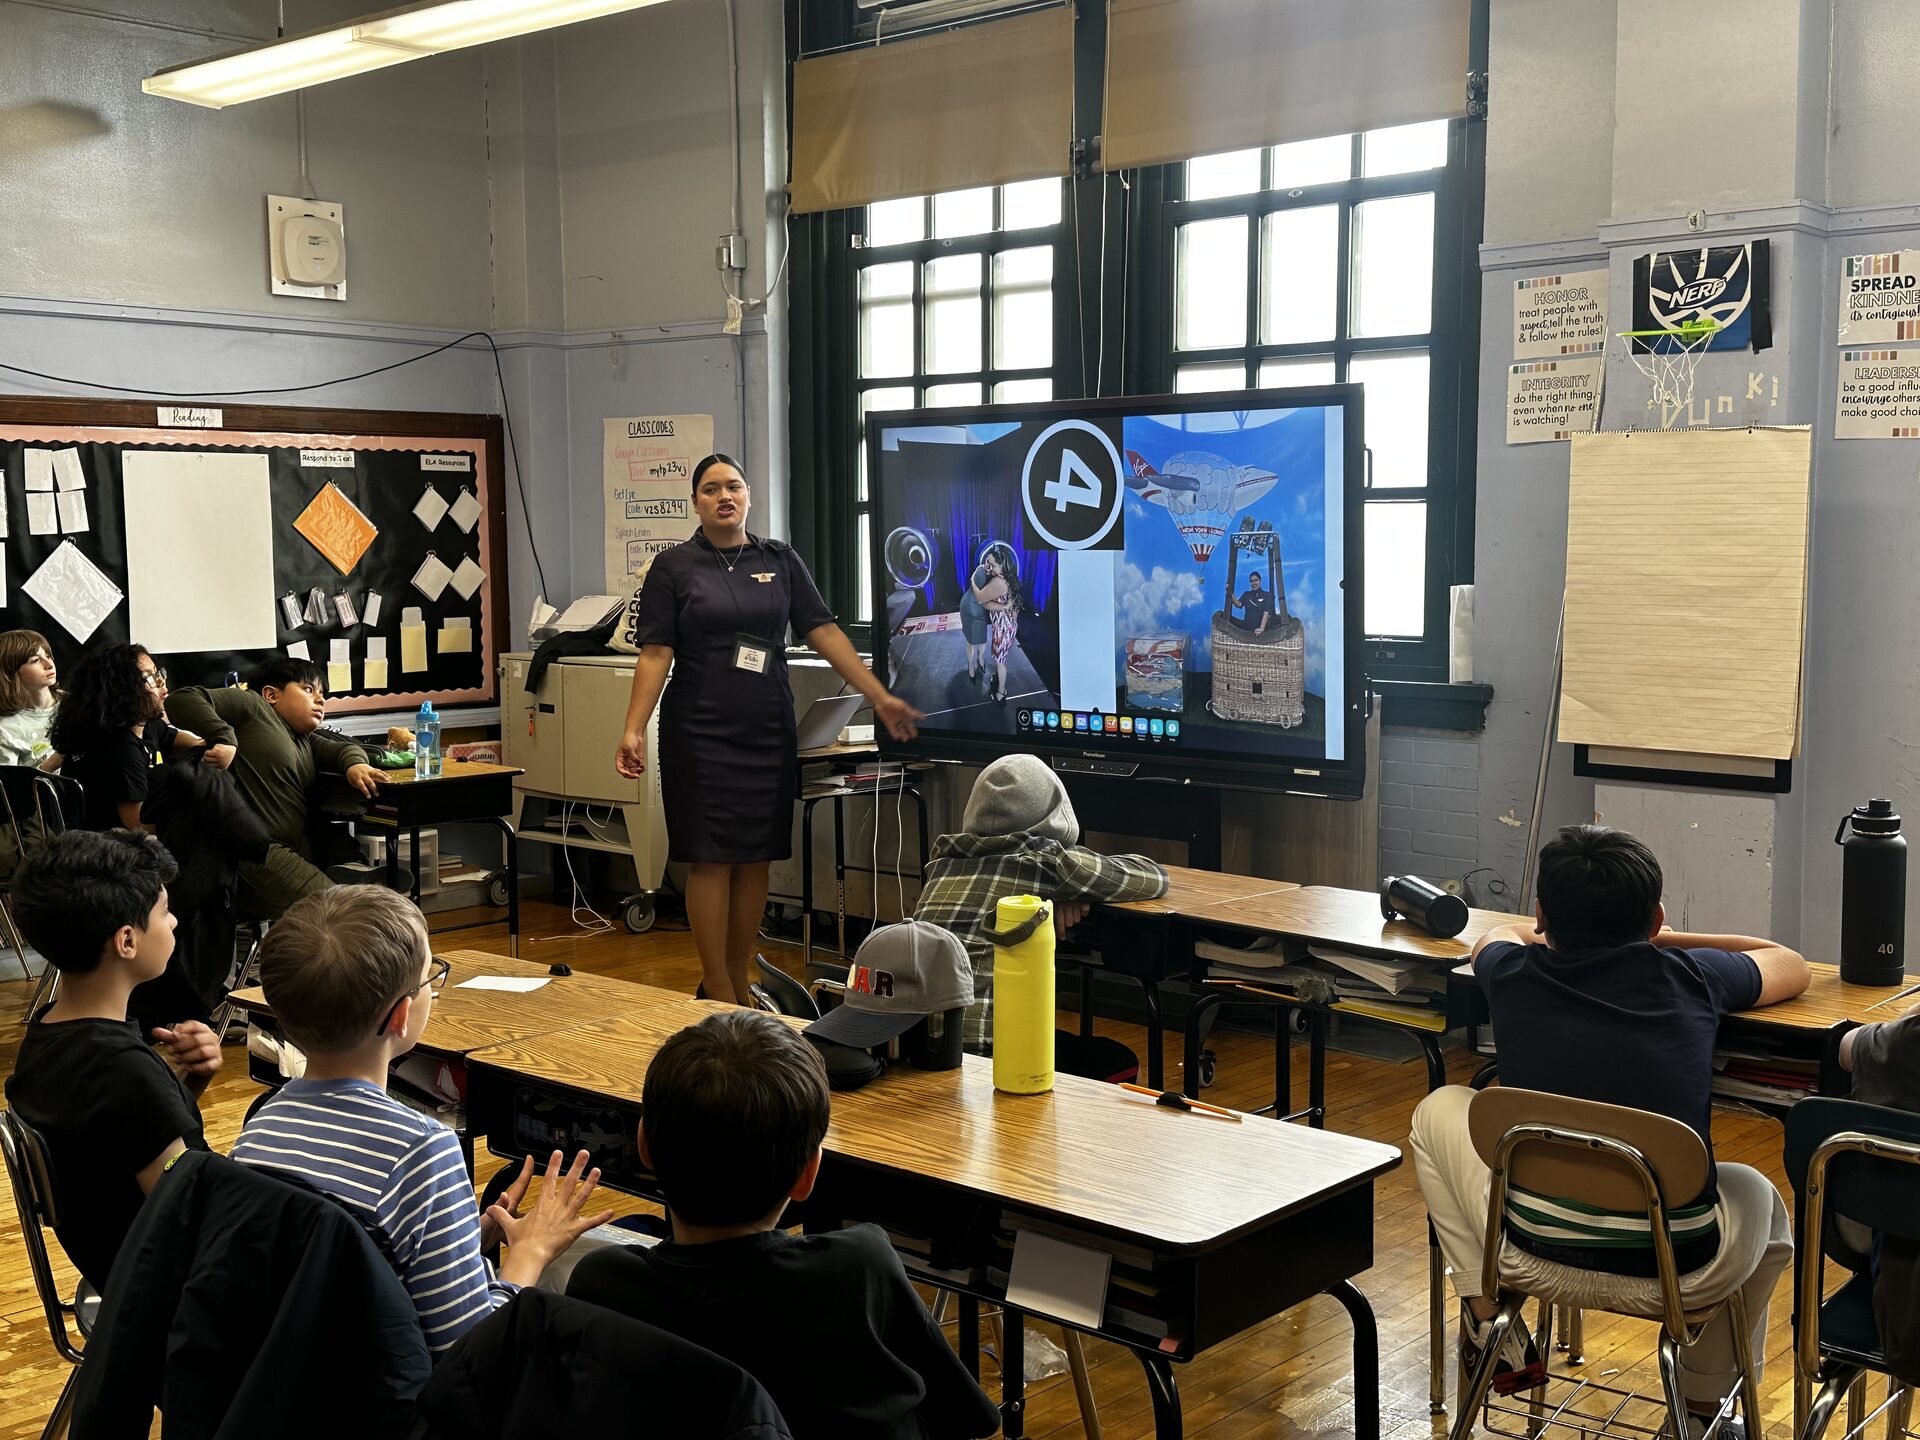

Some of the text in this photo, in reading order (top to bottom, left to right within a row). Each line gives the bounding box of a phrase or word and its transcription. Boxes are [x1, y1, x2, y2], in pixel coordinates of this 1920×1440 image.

[1851, 275, 1917, 293] SPREAD
[1534, 287, 1589, 306] HONOR
[1669, 278, 1727, 309] NERF
[1519, 299, 1598, 319] treat people with
[1866, 304, 1920, 321] contagious!
[1566, 314, 1580, 326] the
[1583, 311, 1604, 324] truth
[1518, 324, 1603, 343] & follow the rules!
[1521, 374, 1591, 391] INTEGRITY
[1843, 381, 1856, 392] be
[1858, 384, 1866, 392] a
[1868, 380, 1895, 394] good
[1513, 393, 1526, 404] do
[1528, 391, 1543, 402] the
[1546, 391, 1567, 404] right
[1841, 395, 1891, 405] encourage
[172, 407, 208, 427] Reading
[1513, 402, 1594, 416] even when no one
[1841, 406, 1868, 417] make
[1870, 405, 1897, 419] good
[1513, 413, 1569, 426] is watching!
[425, 458, 466, 467] ELA Resources
[1044, 448, 1102, 513] 4
[1877, 943, 1894, 955] 40
